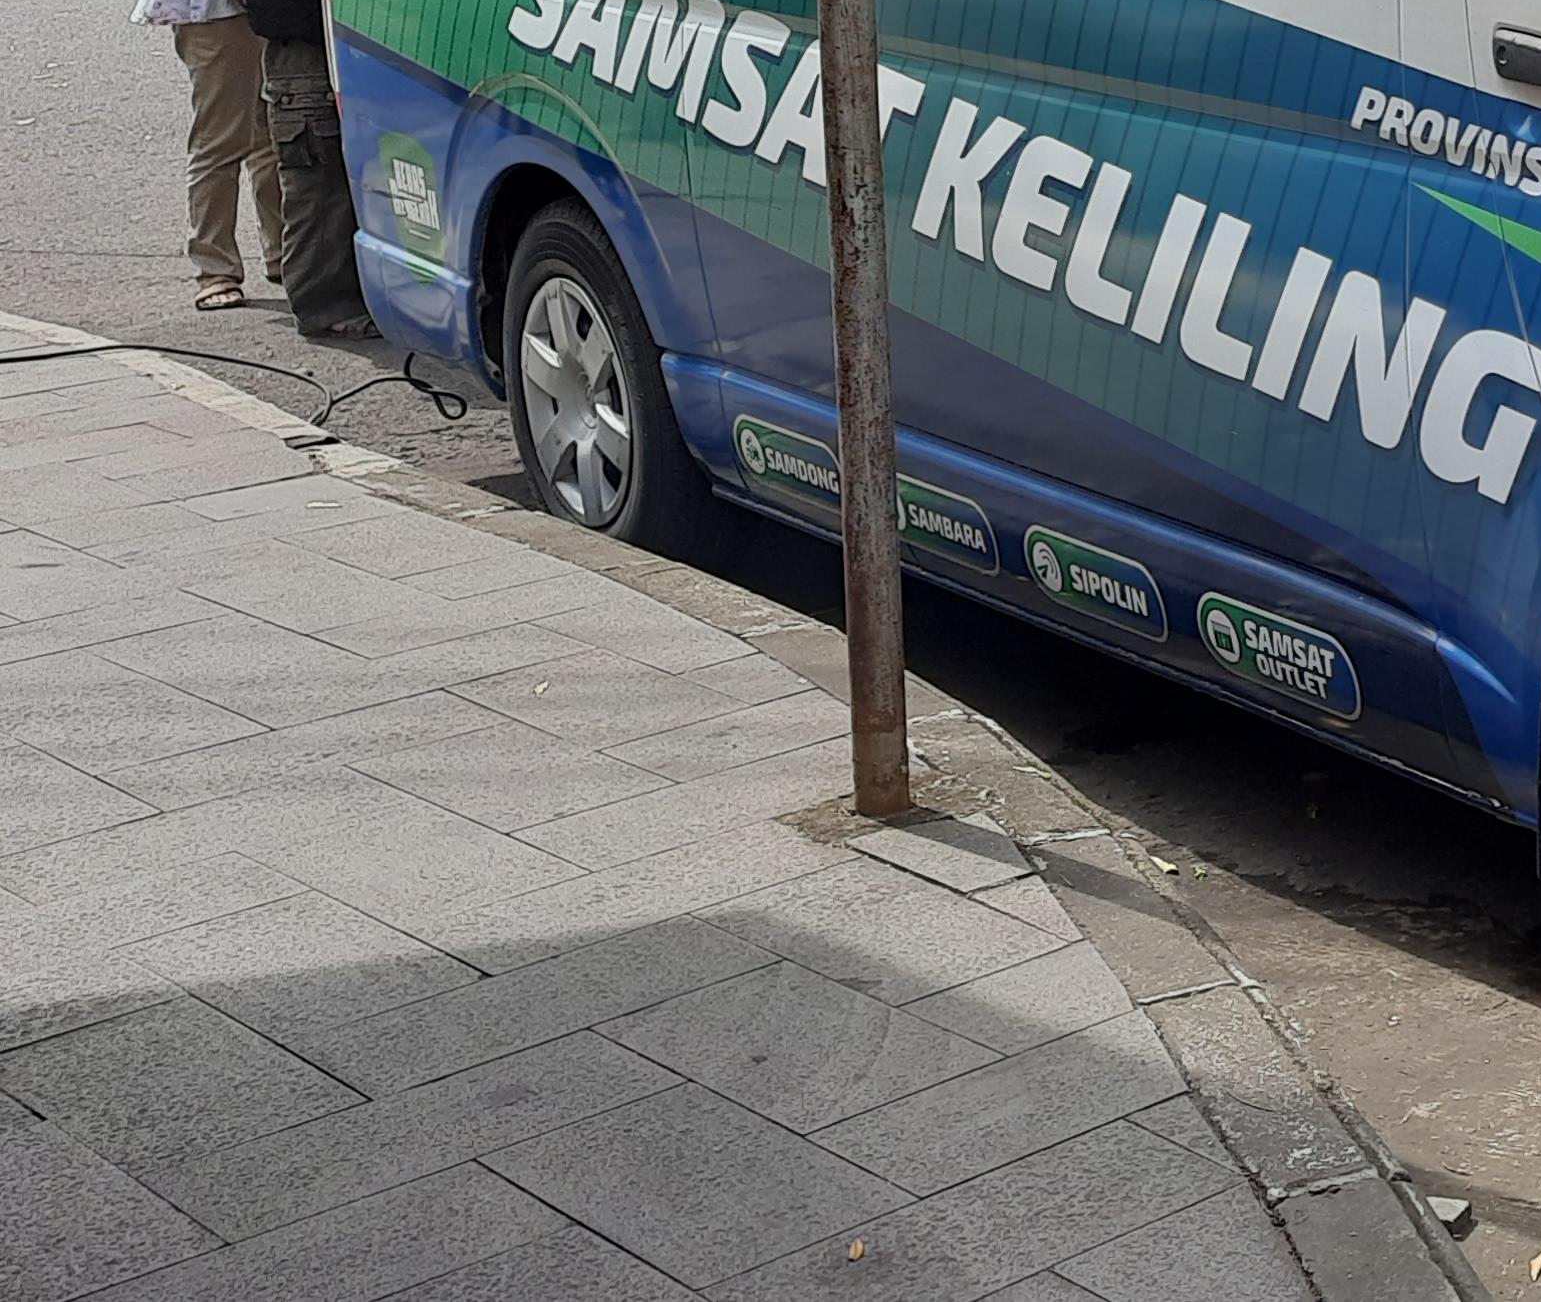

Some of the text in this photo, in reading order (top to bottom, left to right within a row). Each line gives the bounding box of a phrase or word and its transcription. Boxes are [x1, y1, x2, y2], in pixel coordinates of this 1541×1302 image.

[764, 447, 840, 495] SAMDONG
[907, 502, 988, 554] SAMBARA
[1069, 564, 1149, 618] SIPOLIN
[1243, 619, 1336, 678] SAMSAT
[1255, 653, 1328, 699] OUTLET
